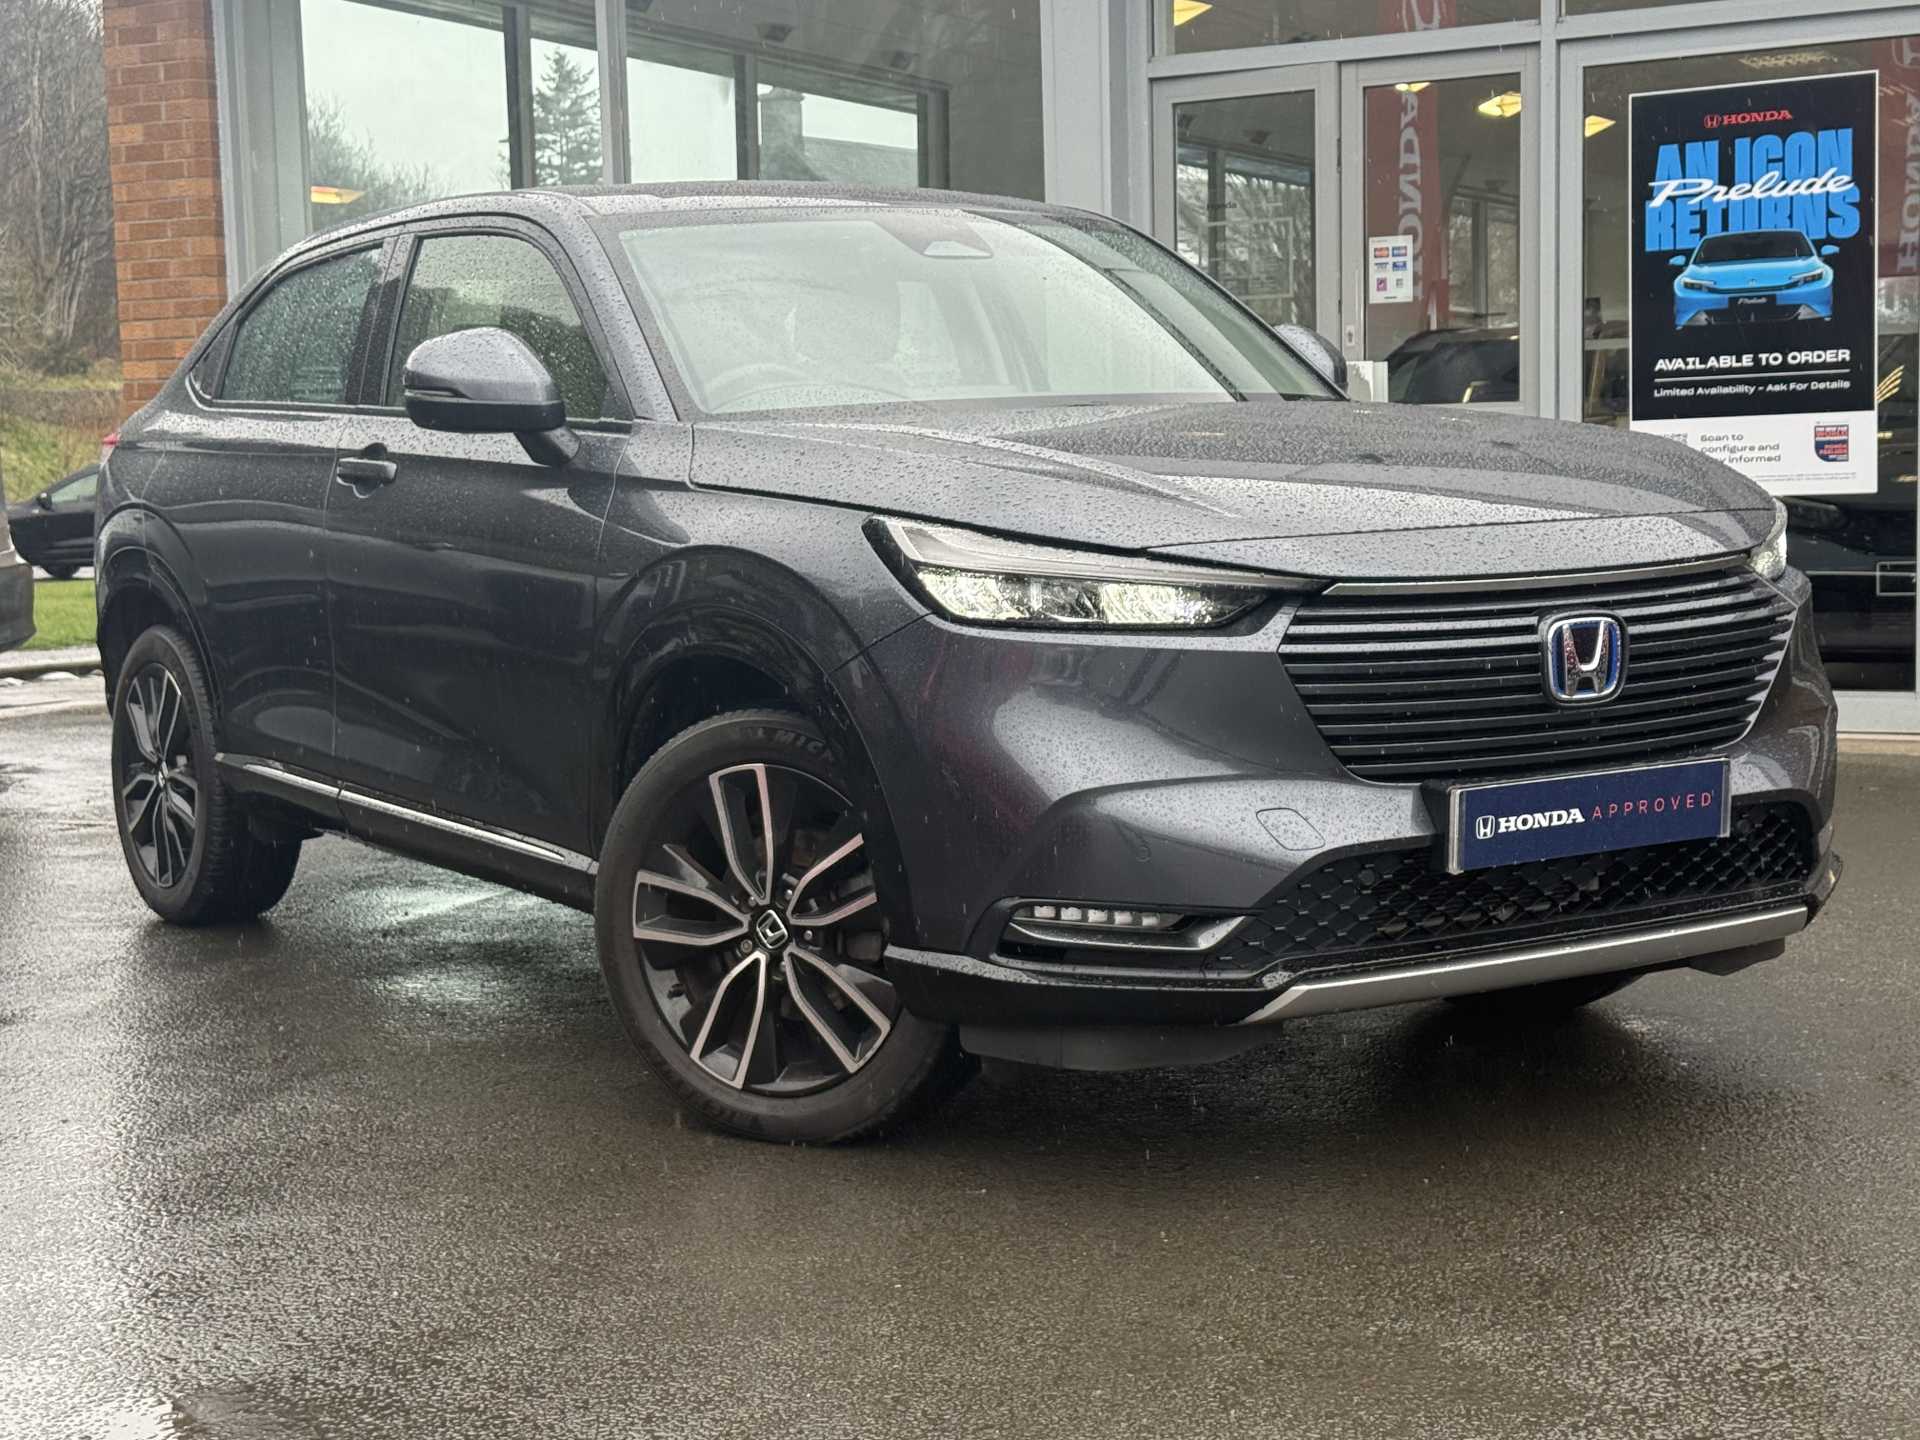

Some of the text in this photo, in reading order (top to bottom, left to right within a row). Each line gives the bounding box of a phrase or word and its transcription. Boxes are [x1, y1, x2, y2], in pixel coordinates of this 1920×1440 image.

[1723, 110, 1793, 127] HONDA
[1653, 128, 1853, 197] AN ICON
[1648, 167, 1855, 208] Prelude
[1645, 186, 1860, 252] RETURNS
[1654, 349, 1851, 373] AVAILABLE TO ORDER
[1654, 386, 1695, 397] Limited
[1696, 384, 1756, 396] Availability
[1766, 383, 1788, 392] Ask
[1789, 381, 1808, 391] For
[1810, 379, 1851, 390] Details
[1700, 433, 1744, 442] Scan to
[1701, 443, 1780, 455] configure and
[1728, 454, 1781, 464] informed
[1498, 808, 1585, 833] HONDA
[1592, 792, 1712, 821] APPROVED
